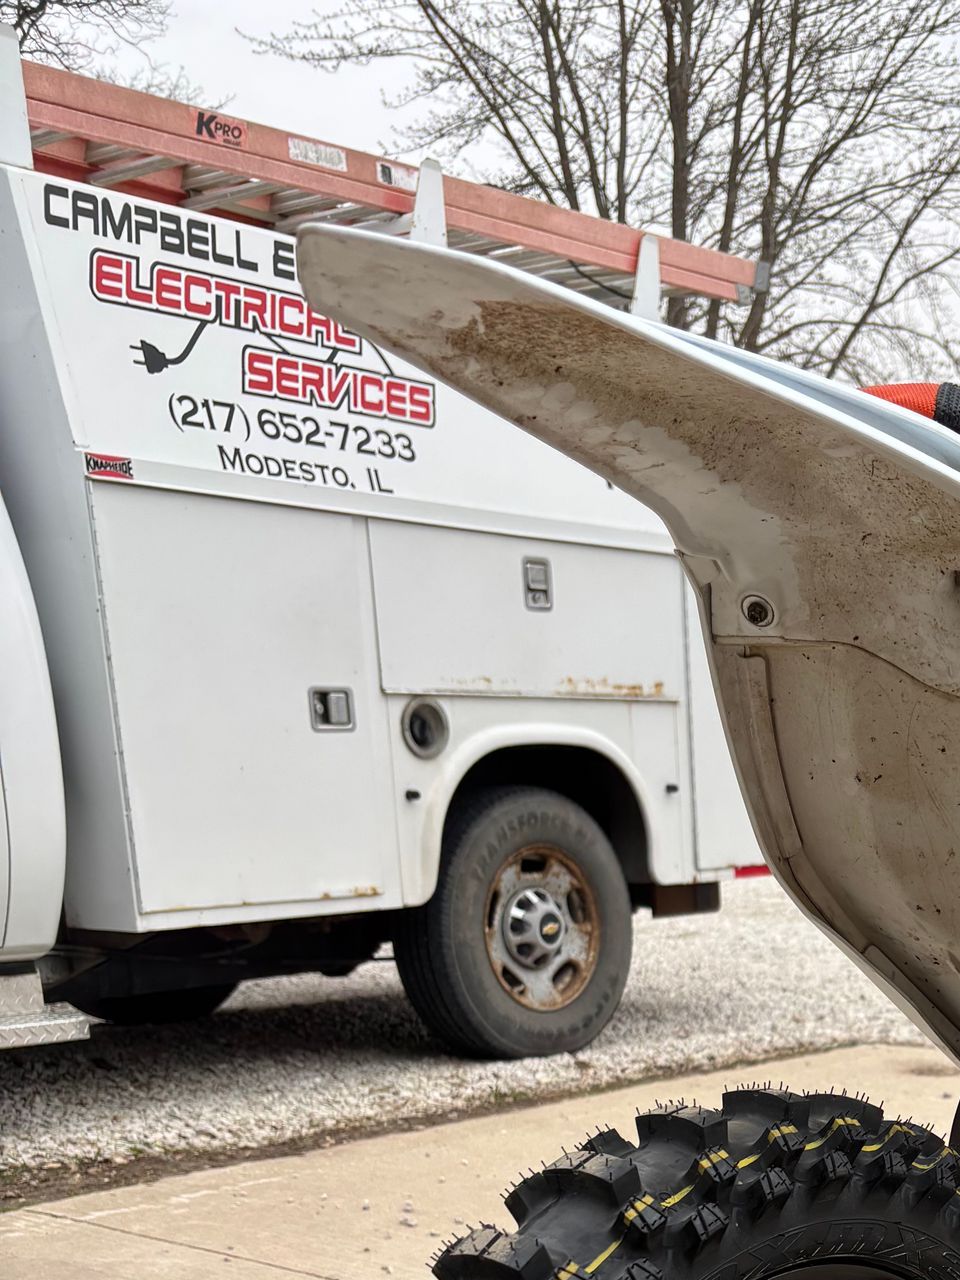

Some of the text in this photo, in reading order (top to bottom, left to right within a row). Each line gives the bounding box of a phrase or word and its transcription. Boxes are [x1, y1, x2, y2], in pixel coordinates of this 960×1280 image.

[44, 183, 258, 273] CAMPBELL
[95, 254, 356, 348] ELECTRICAL
[246, 352, 431, 422] SERVICES
[168, 392, 417, 463] (217) 652-7233
[366, 468, 395, 494] IL
